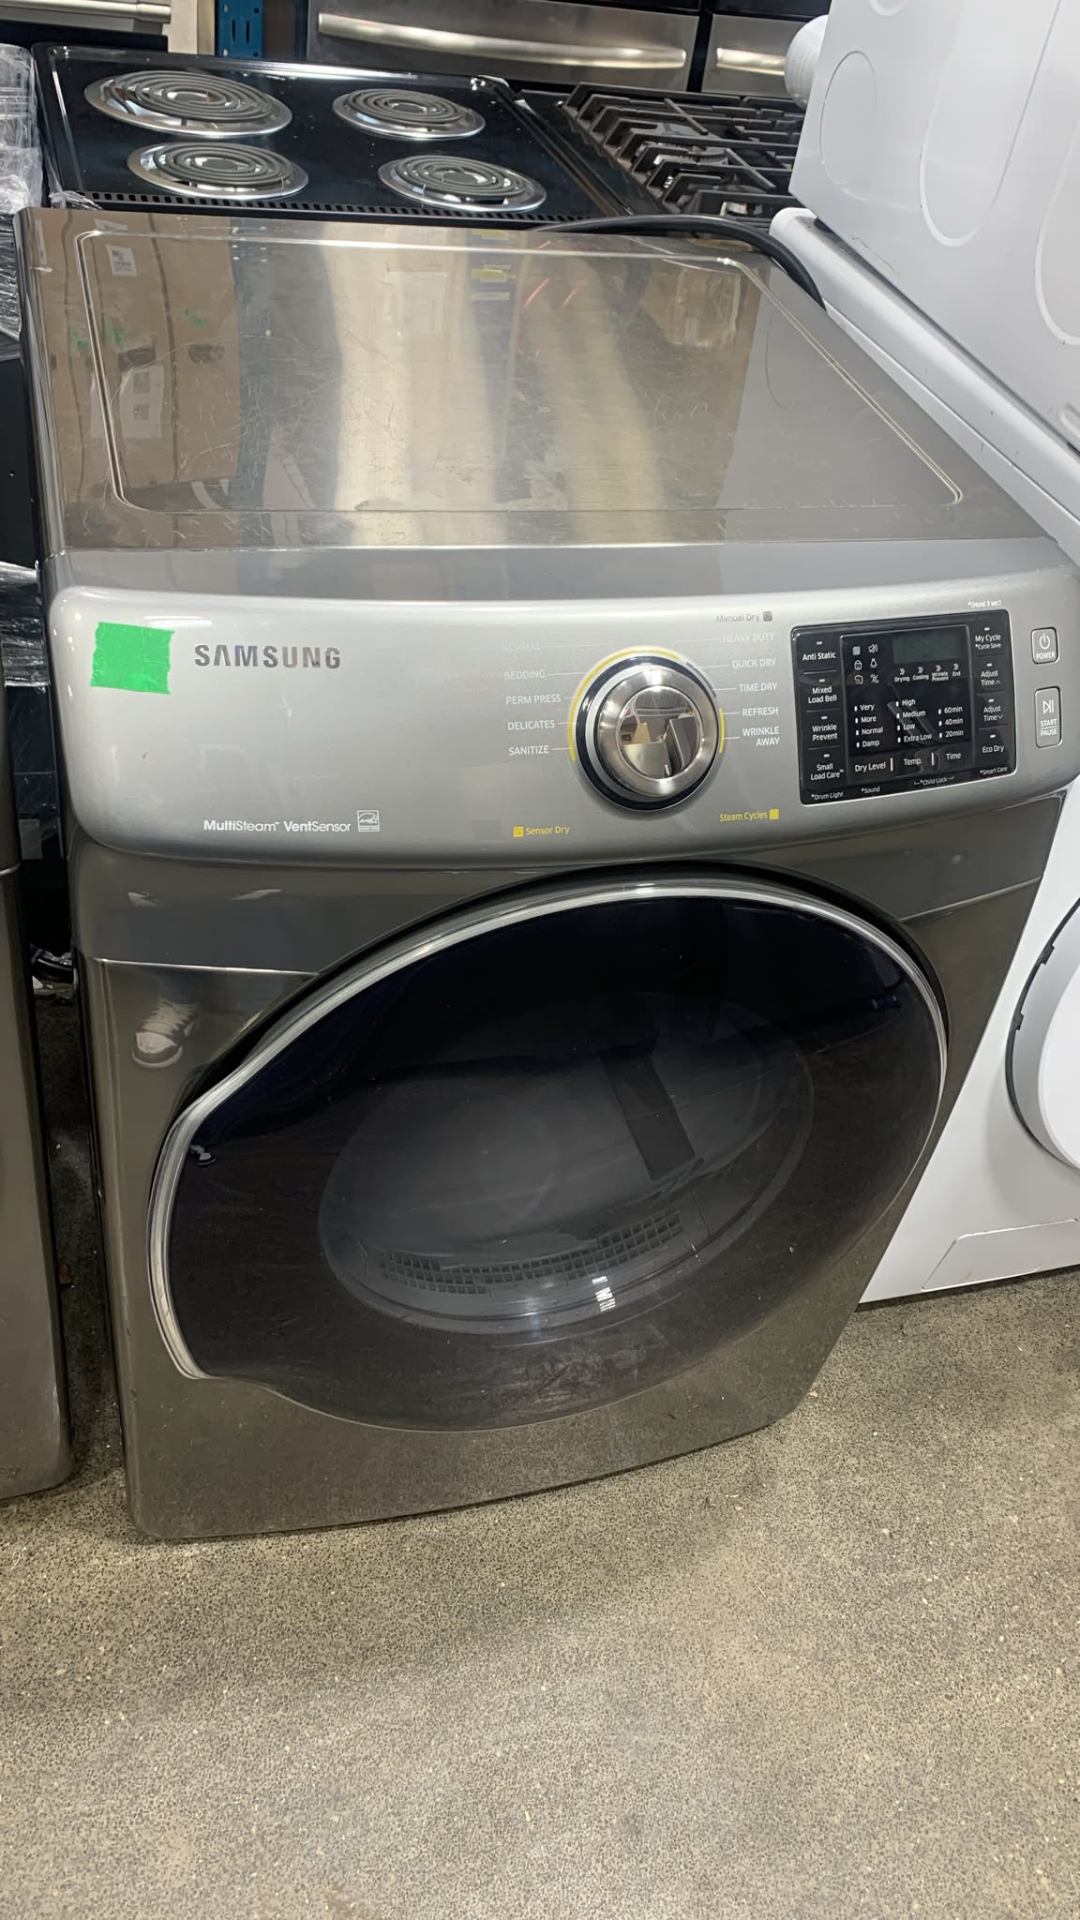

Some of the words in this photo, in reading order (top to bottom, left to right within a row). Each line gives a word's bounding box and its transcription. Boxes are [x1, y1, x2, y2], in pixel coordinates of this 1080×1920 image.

[716, 614, 744, 623] Manual
[746, 613, 760, 622] Dry
[985, 634, 1001, 642] Cycle
[195, 645, 341, 669] SAMSUNG
[802, 652, 816, 661] Anti
[817, 651, 836, 660] Static
[732, 660, 758, 669] QUICK
[759, 658, 776, 667] DRY
[504, 670, 545, 680] BEDDING
[981, 670, 998, 679] Adjust
[739, 684, 758, 692] TIME
[759, 682, 778, 690] DRY
[812, 686, 832, 694] Mixed
[506, 696, 532, 705] PERM
[534, 694, 562, 703] PRESS
[808, 695, 823, 703] Load
[824, 694, 837, 702] Bell
[902, 699, 916, 707] High
[860, 703, 875, 712] Very
[944, 706, 963, 714] 60min
[983, 705, 1001, 714] Adjust
[742, 708, 779, 717] REFRESH
[903, 709, 926, 718] Medium
[861, 715, 877, 723] More
[945, 717, 963, 726] 40min
[1040, 718, 1057, 726] START
[507, 720, 555, 730] DELICATES
[812, 723, 837, 732] Wrinkle
[903, 723, 915, 731] Low
[742, 726, 780, 736] WRINKLE
[861, 726, 883, 735] Normal
[945, 729, 964, 738] 20min
[812, 732, 837, 741] Prevent
[904, 734, 918, 742] Extra
[919, 733, 932, 741] Low
[756, 737, 780, 746] AWAY
[862, 739, 880, 748] Damp
[508, 745, 549, 756] SANITIZE
[982, 745, 993, 753] Eco
[993, 744, 1004, 753] Dry
[946, 751, 961, 760] Time
[816, 763, 833, 771] Small
[855, 763, 867, 772] Dry
[868, 761, 886, 770] Level
[811, 772, 824, 780] Load
[719, 812, 742, 822] Steam
[744, 810, 768, 822] Cycles
[284, 821, 351, 832] VentSensor
[526, 826, 553, 835] Sensor
[555, 825, 570, 835] Dry
